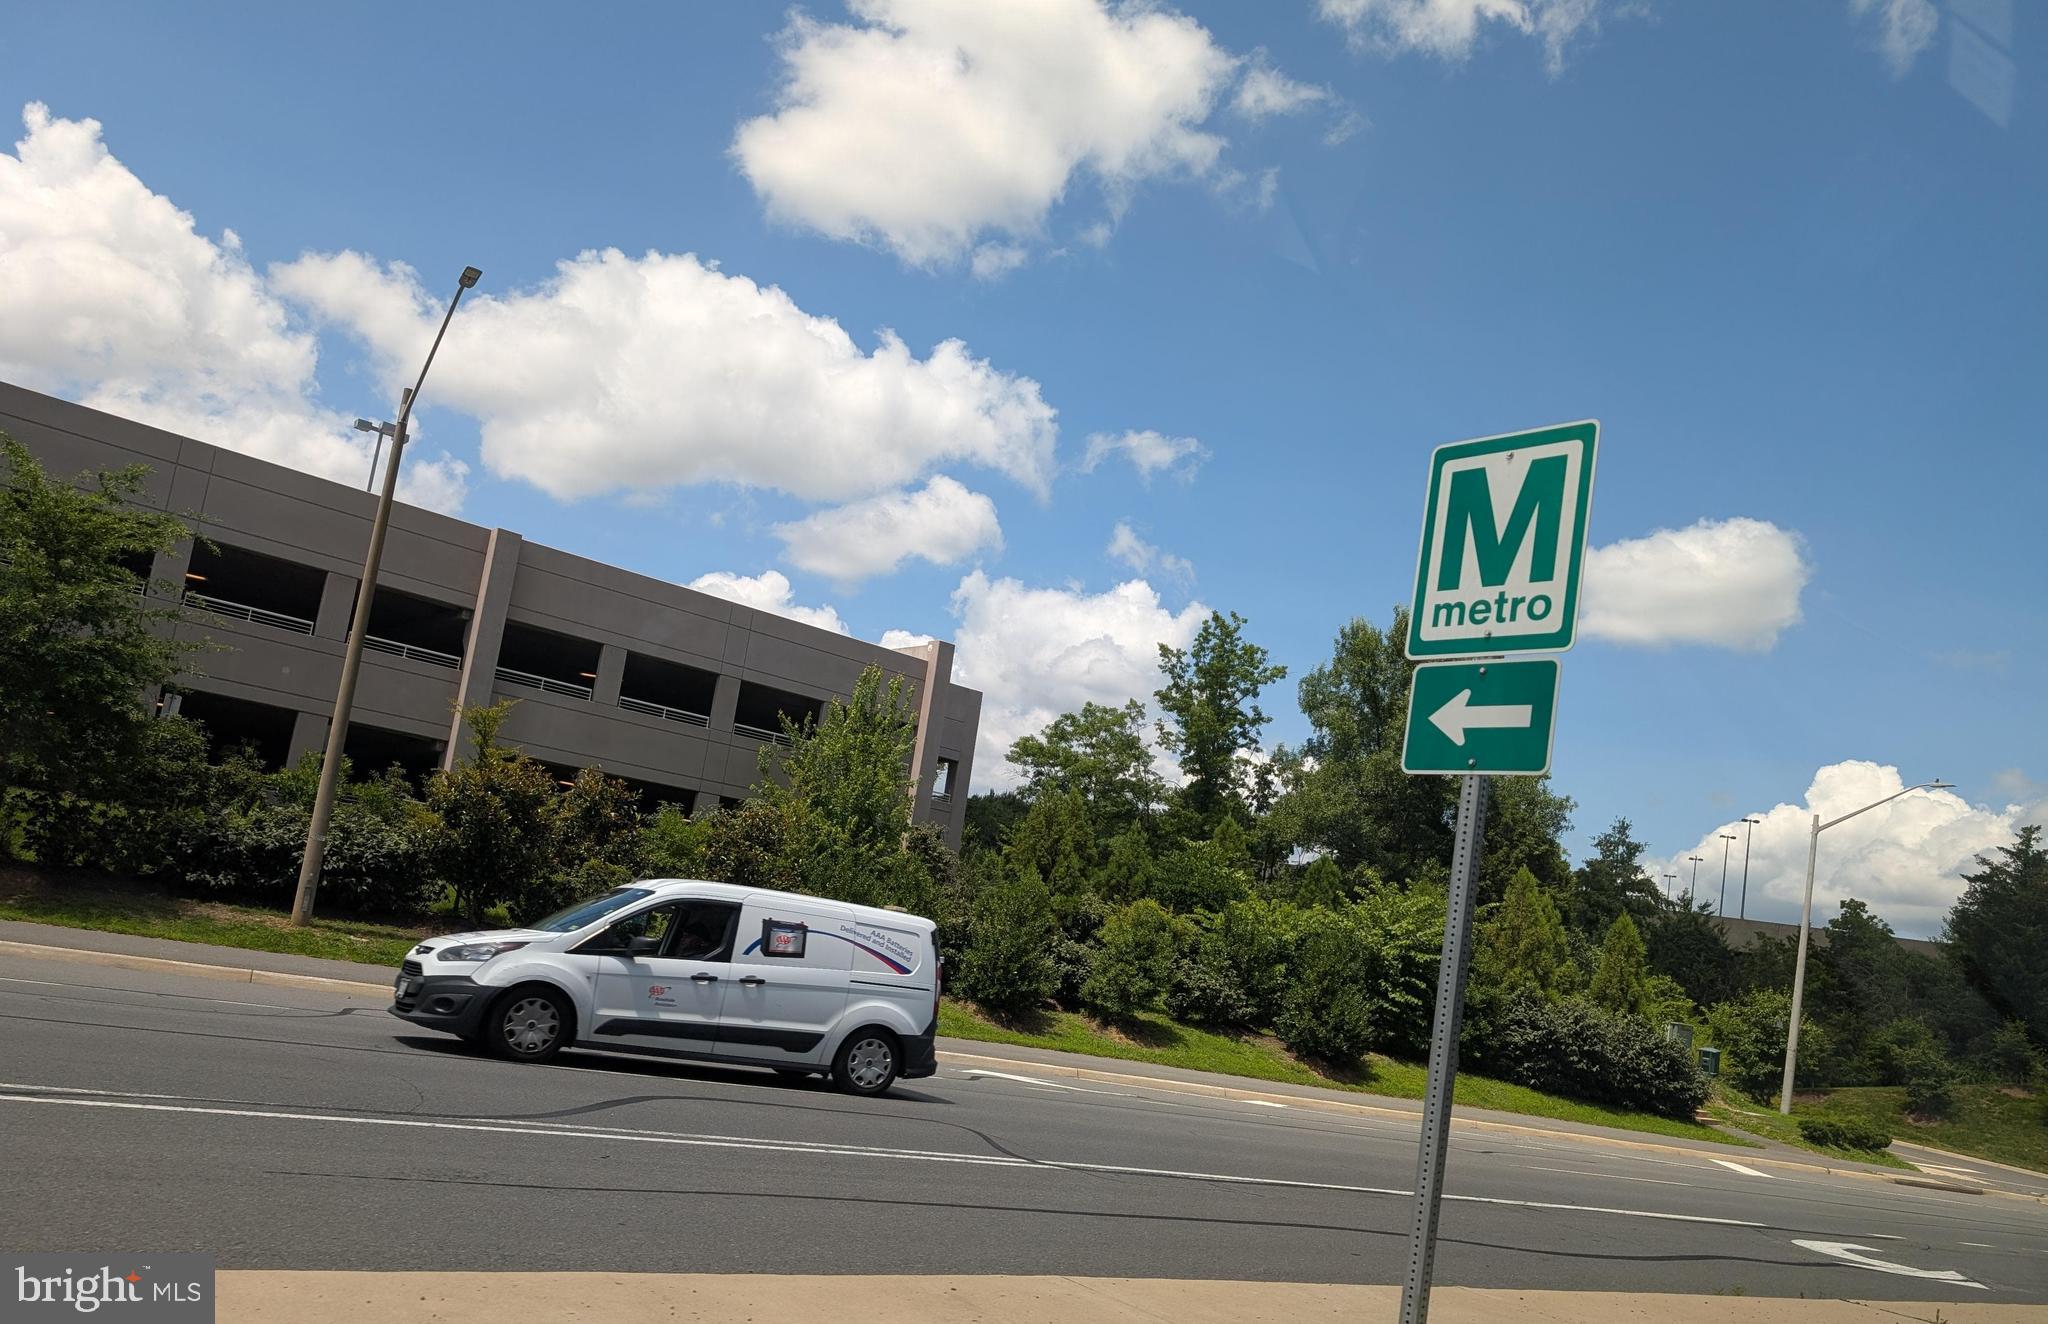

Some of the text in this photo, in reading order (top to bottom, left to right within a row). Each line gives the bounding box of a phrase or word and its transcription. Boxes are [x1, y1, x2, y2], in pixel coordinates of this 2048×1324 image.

[1437, 454, 1569, 591] M
[1431, 591, 1552, 627] metro
[840, 924, 912, 963] Delivered and Installed
[870, 930, 913, 957] AAA Batteries
